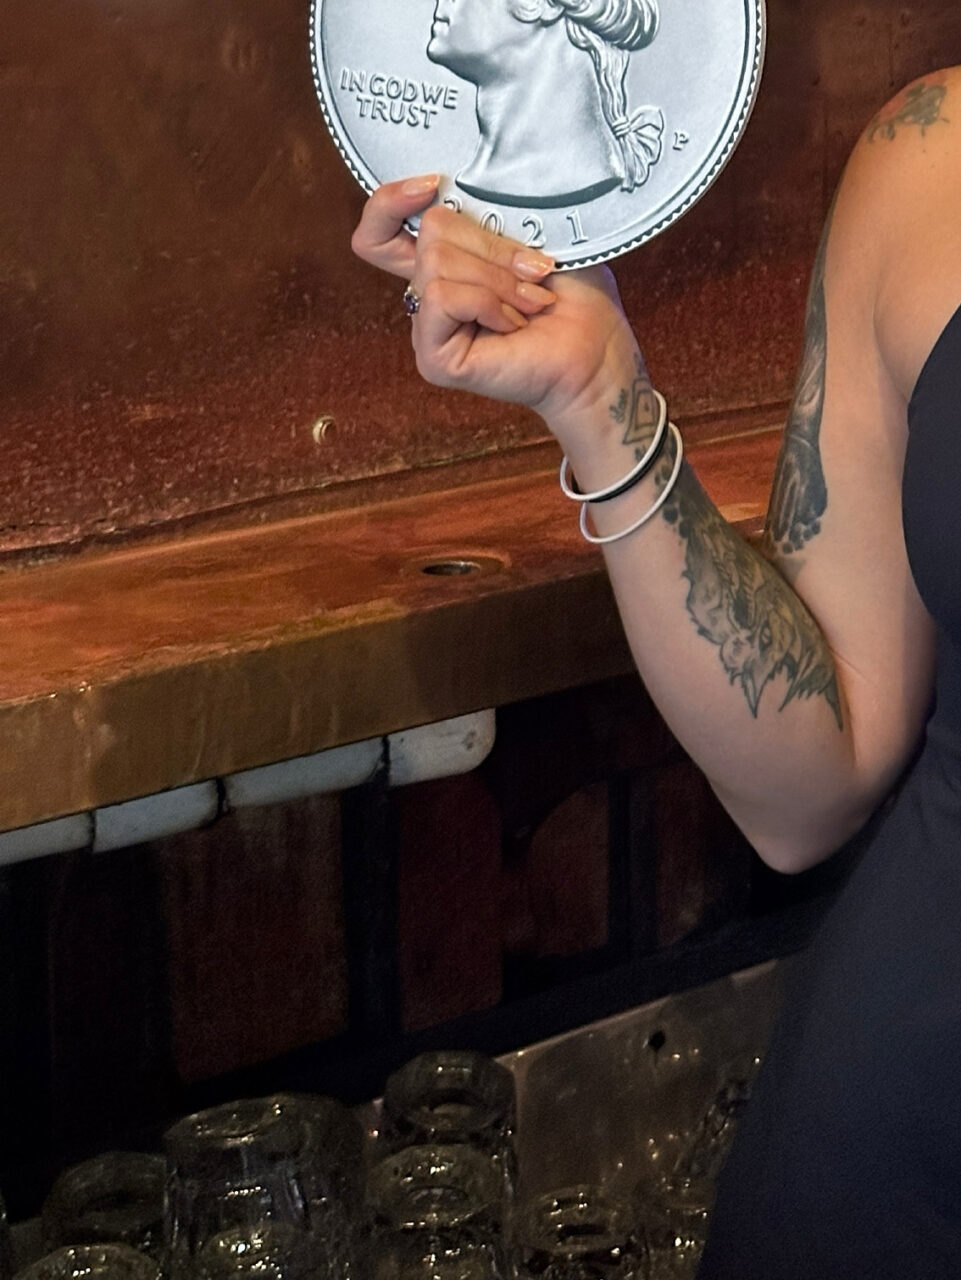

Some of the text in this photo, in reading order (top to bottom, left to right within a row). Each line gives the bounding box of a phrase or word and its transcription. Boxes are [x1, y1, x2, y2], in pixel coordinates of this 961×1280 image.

[340, 67, 459, 110] IN GOD WE
[356, 95, 438, 129] TRUST
[672, 131, 690, 151] P
